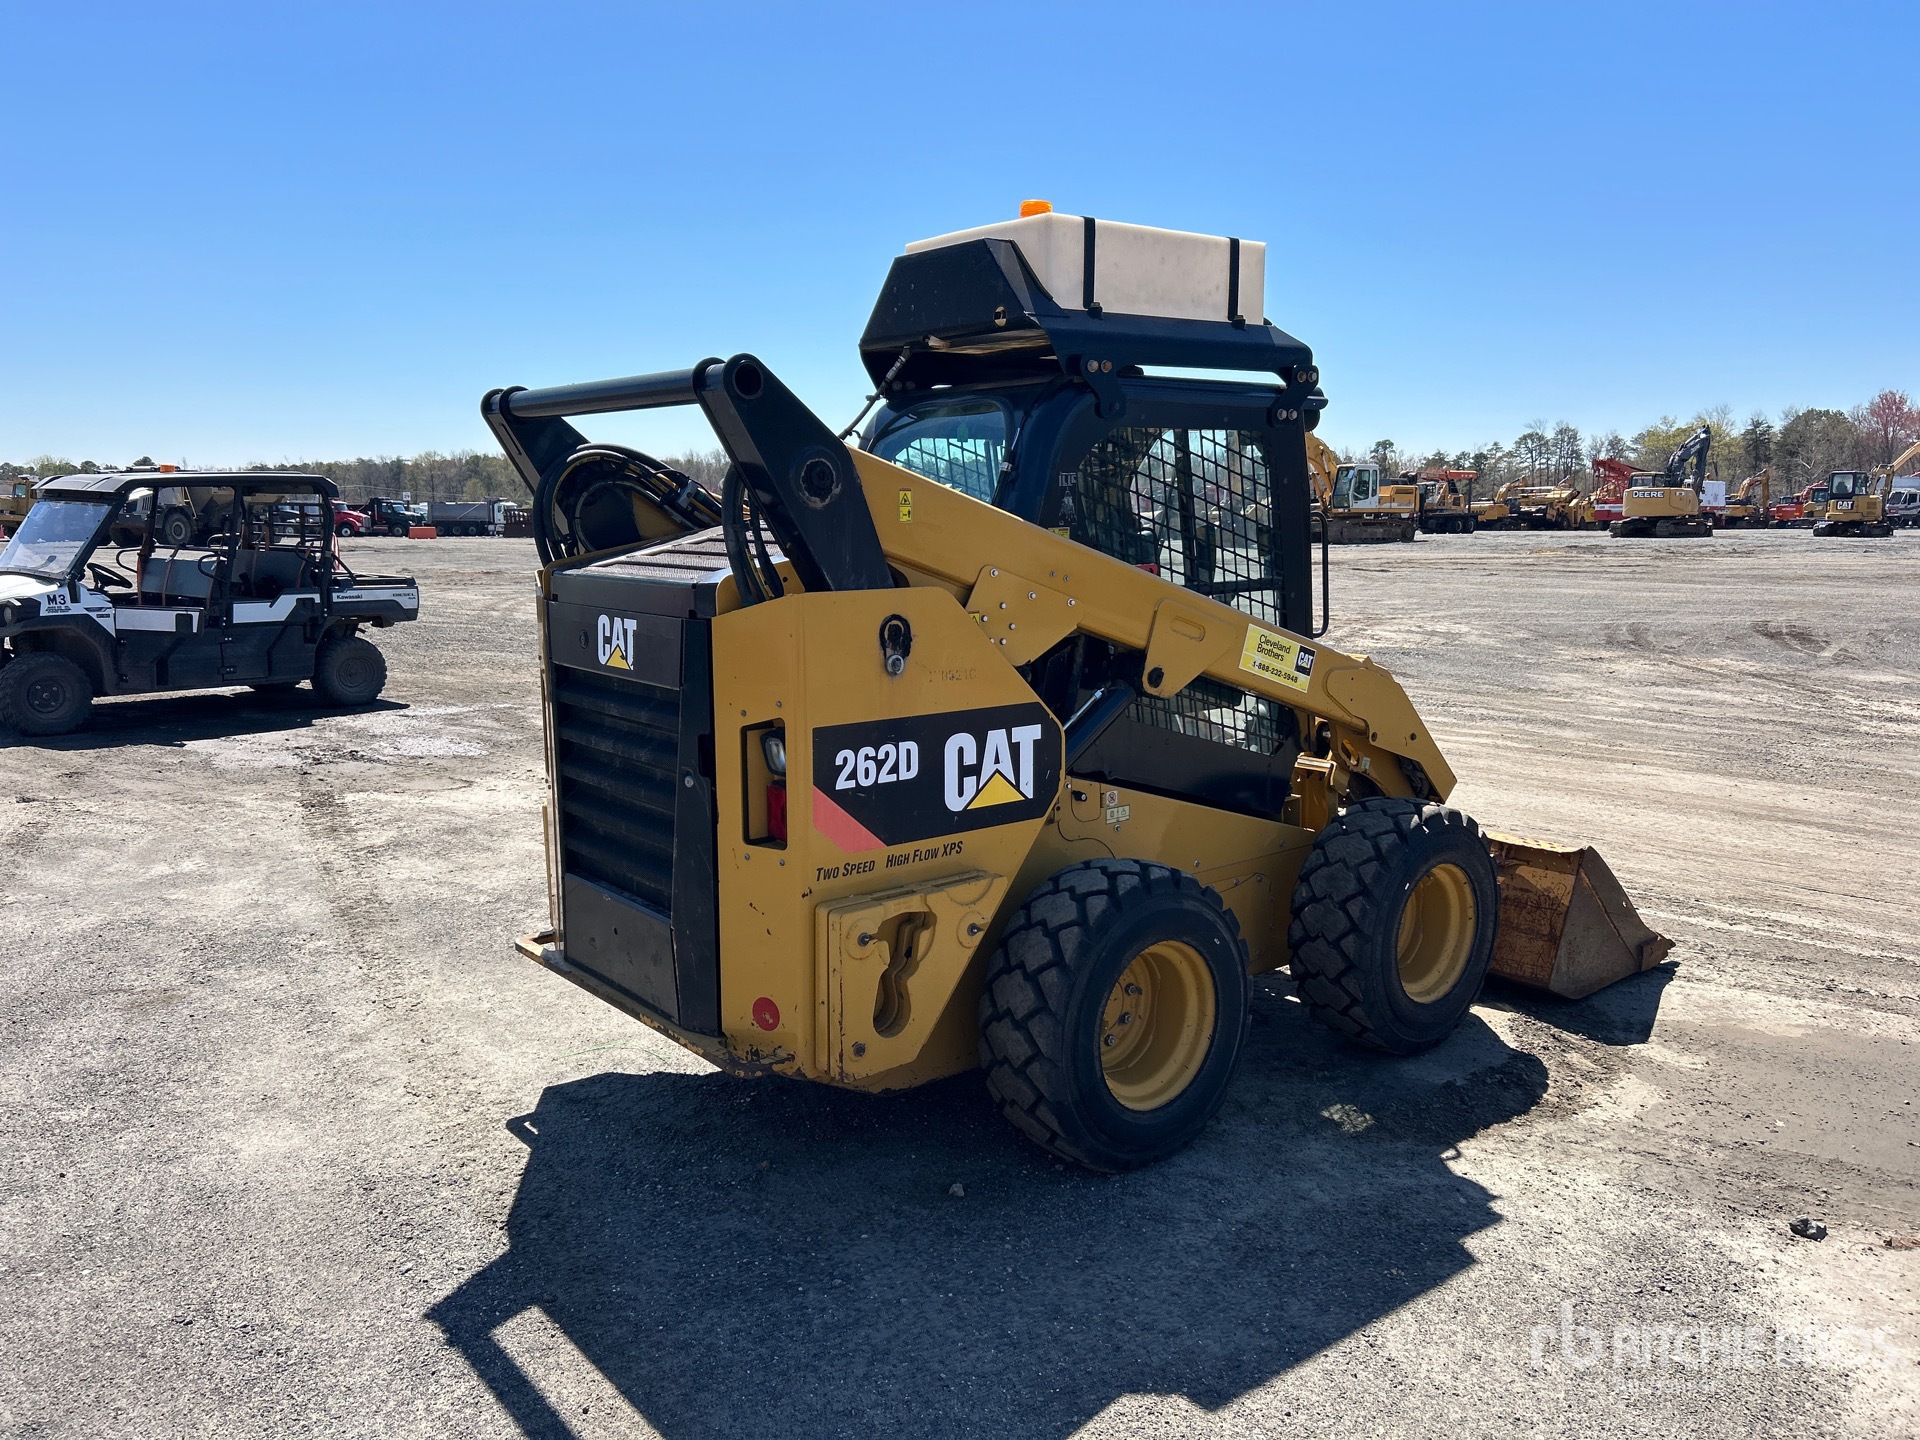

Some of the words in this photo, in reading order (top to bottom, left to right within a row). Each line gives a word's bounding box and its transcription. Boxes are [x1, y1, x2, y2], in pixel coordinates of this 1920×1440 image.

[1837, 501, 1853, 509] CAT
[46, 594, 67, 606] M3
[597, 614, 638, 671] CAT
[1259, 634, 1292, 654] Cleveland
[1256, 643, 1285, 662] Brothers
[1298, 652, 1314, 668] CAT
[1252, 660, 1299, 684] 1-888-232-5948
[834, 740, 919, 791] 262D
[944, 723, 1043, 812] CAT
[941, 841, 964, 858] XPS
